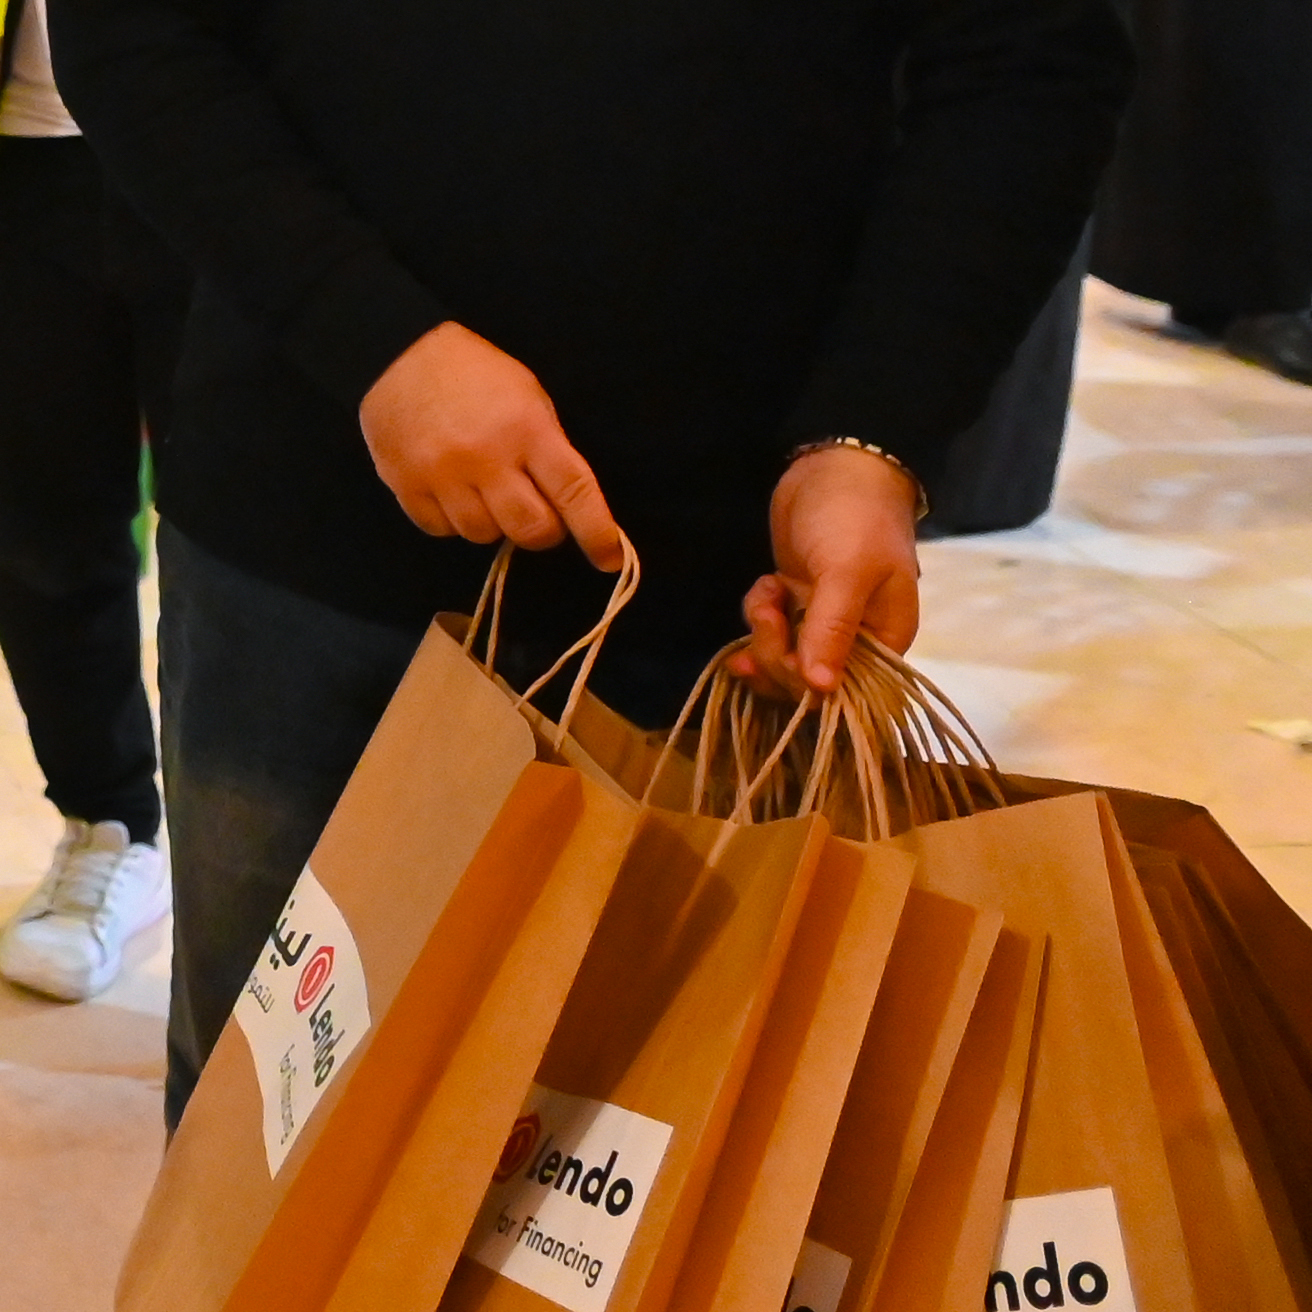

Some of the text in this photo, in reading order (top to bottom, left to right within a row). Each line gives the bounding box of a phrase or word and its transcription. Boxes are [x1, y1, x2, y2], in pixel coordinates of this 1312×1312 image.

[309, 983, 345, 1088] Lendo
[525, 1134, 634, 1217] Lendo
[515, 1215, 604, 1288] Financing
[984, 1241, 1109, 1312] ndo
